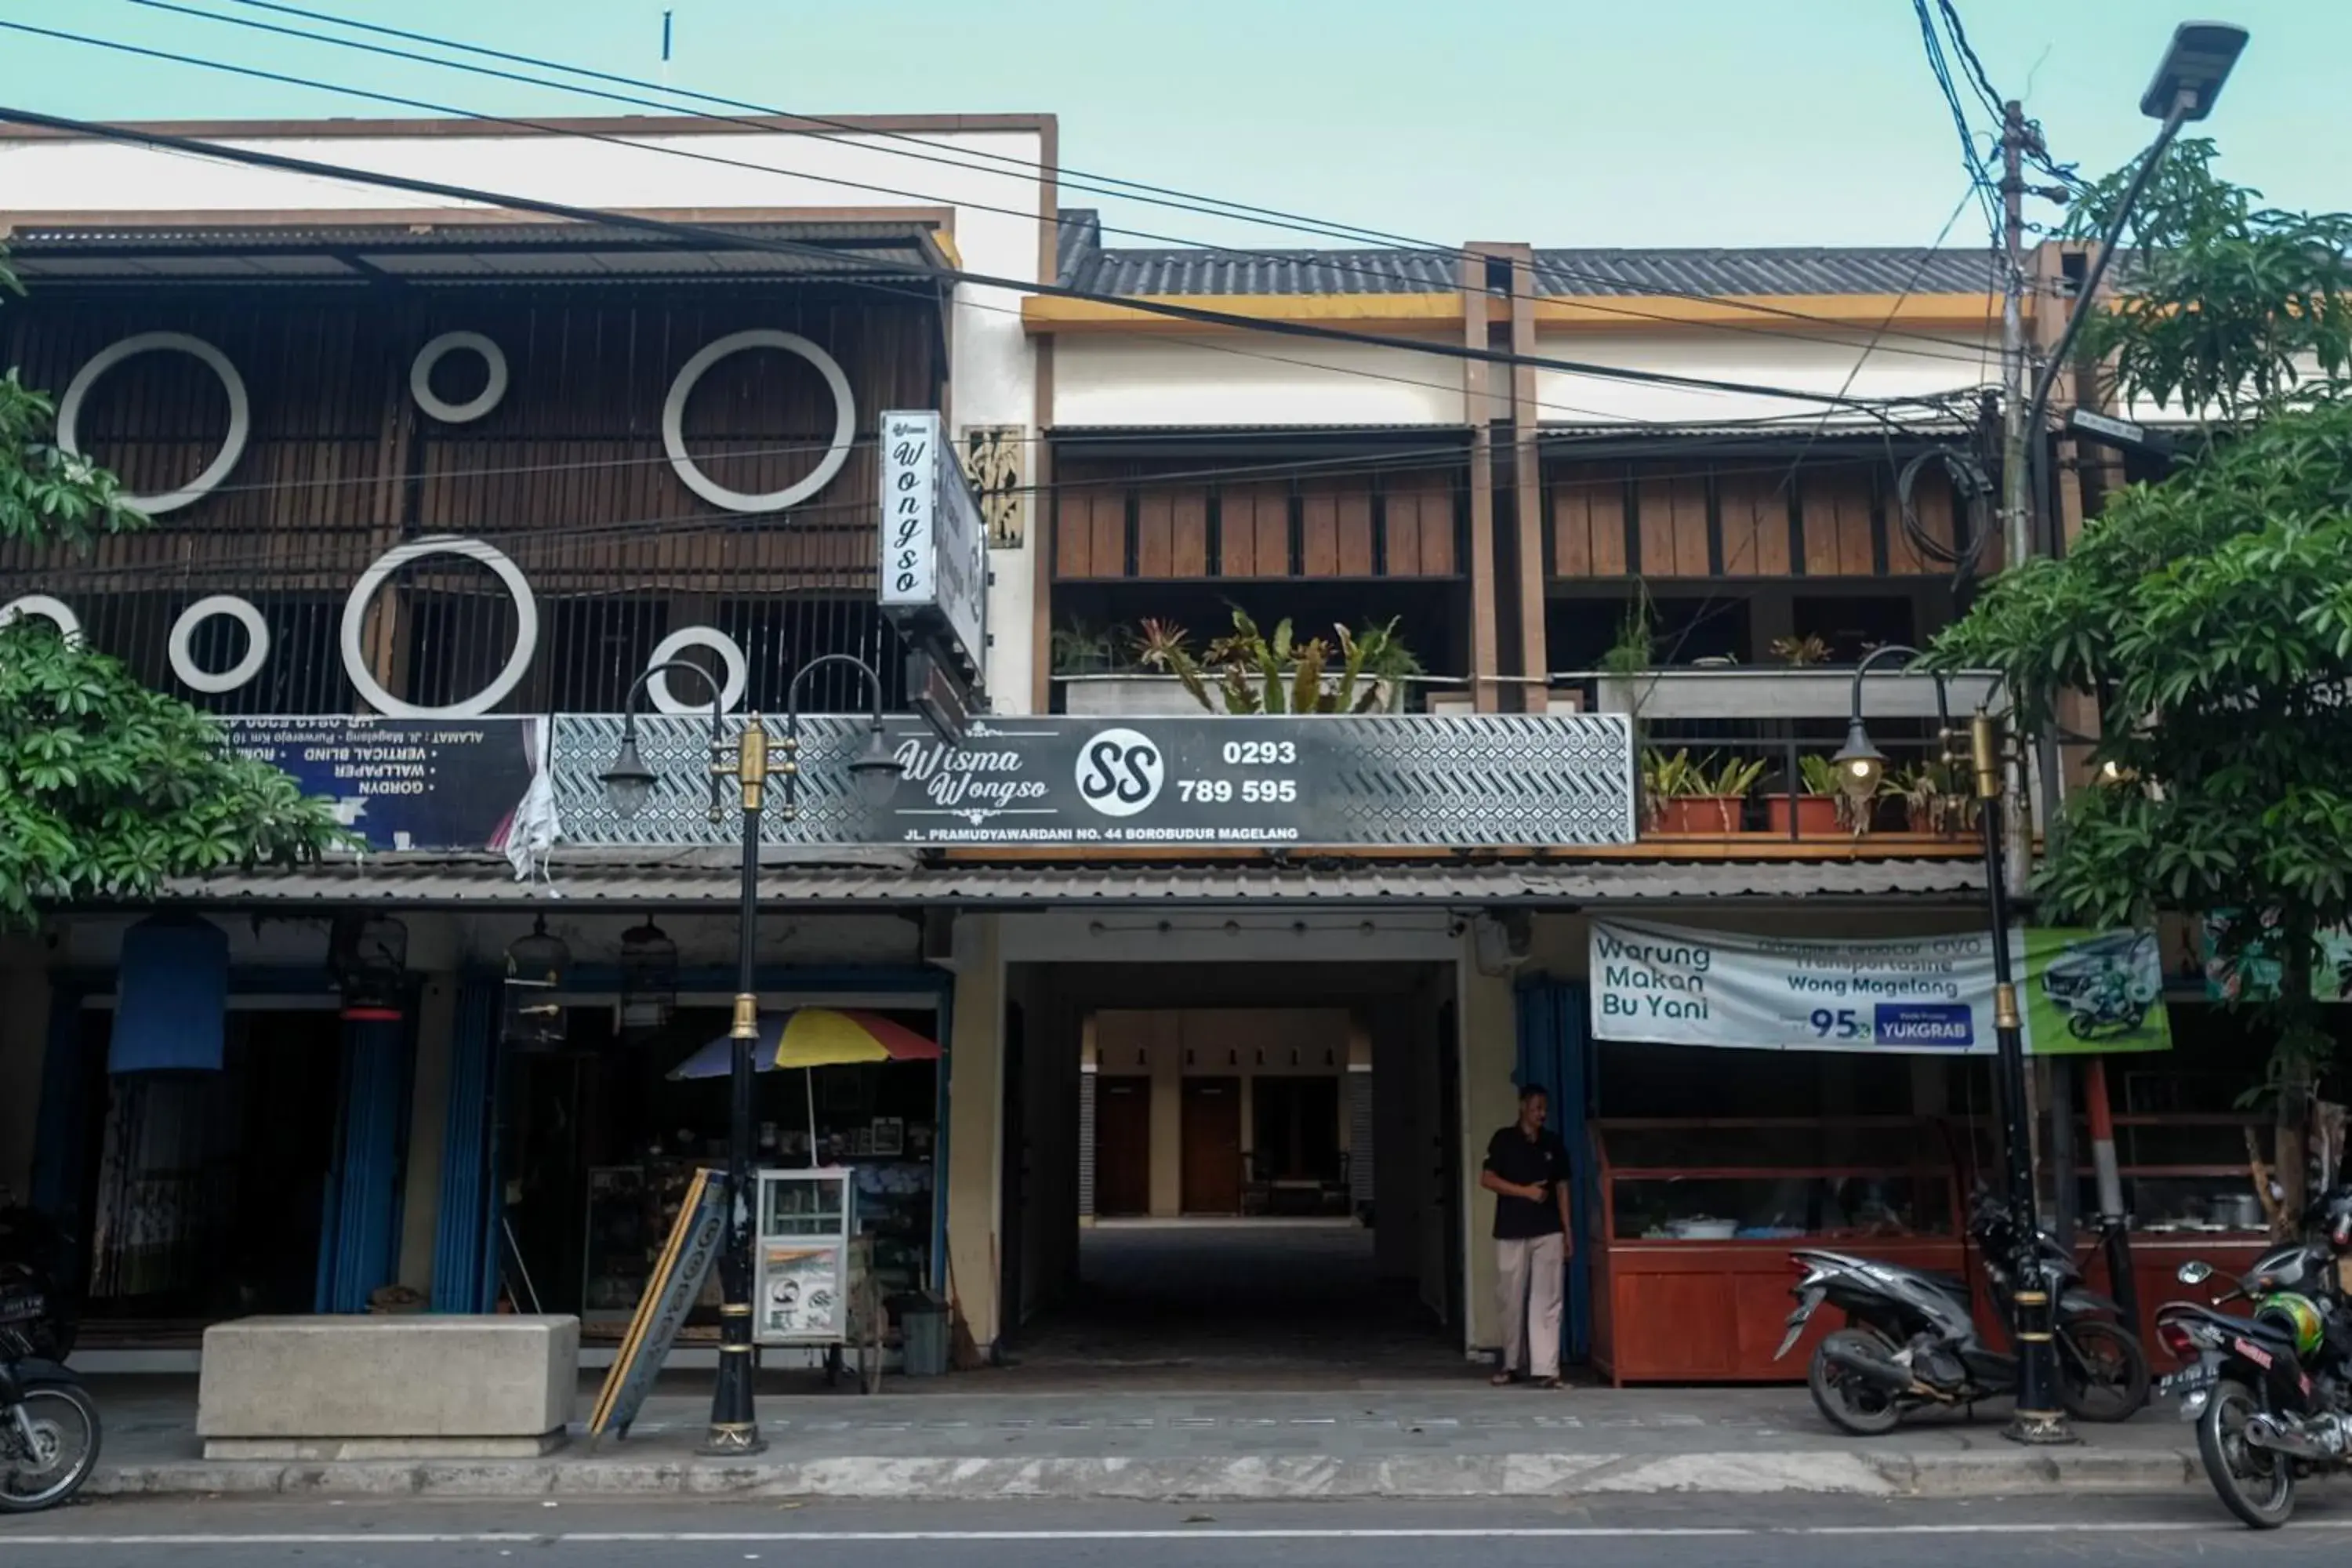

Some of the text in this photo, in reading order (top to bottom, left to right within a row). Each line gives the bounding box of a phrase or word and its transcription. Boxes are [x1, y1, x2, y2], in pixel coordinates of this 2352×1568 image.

[893, 441, 926, 593] Wongso
[232, 731, 247, 744] 10
[250, 731, 271, 744] Km
[274, 731, 336, 746] Purwerejo
[345, 729, 405, 744] Magelang
[431, 731, 485, 743] ALAMAT
[303, 746, 426, 760] VERTICAL BLIND
[893, 738, 1023, 781] Wisma
[1222, 741, 1297, 764] 0293
[334, 764, 426, 778] WALLPAPER
[1082, 740, 1157, 804] SS
[358, 781, 423, 794] GORDYN
[927, 771, 1050, 808] Wongso
[1177, 780, 1297, 802] 789 595
[904, 829, 926, 840] JL.
[1076, 828, 1101, 840] NO.
[1104, 828, 1123, 840] 44
[1125, 827, 1216, 840] BOROBUDUR
[1218, 827, 1298, 840] MAGELANG
[1597, 937, 1711, 972] Warung
[1605, 965, 1704, 993] Makan
[1787, 975, 1958, 999] Wong Magelang
[1602, 993, 1709, 1020] Bu Yani
[1882, 1022, 1967, 1039] YUKGRAB
